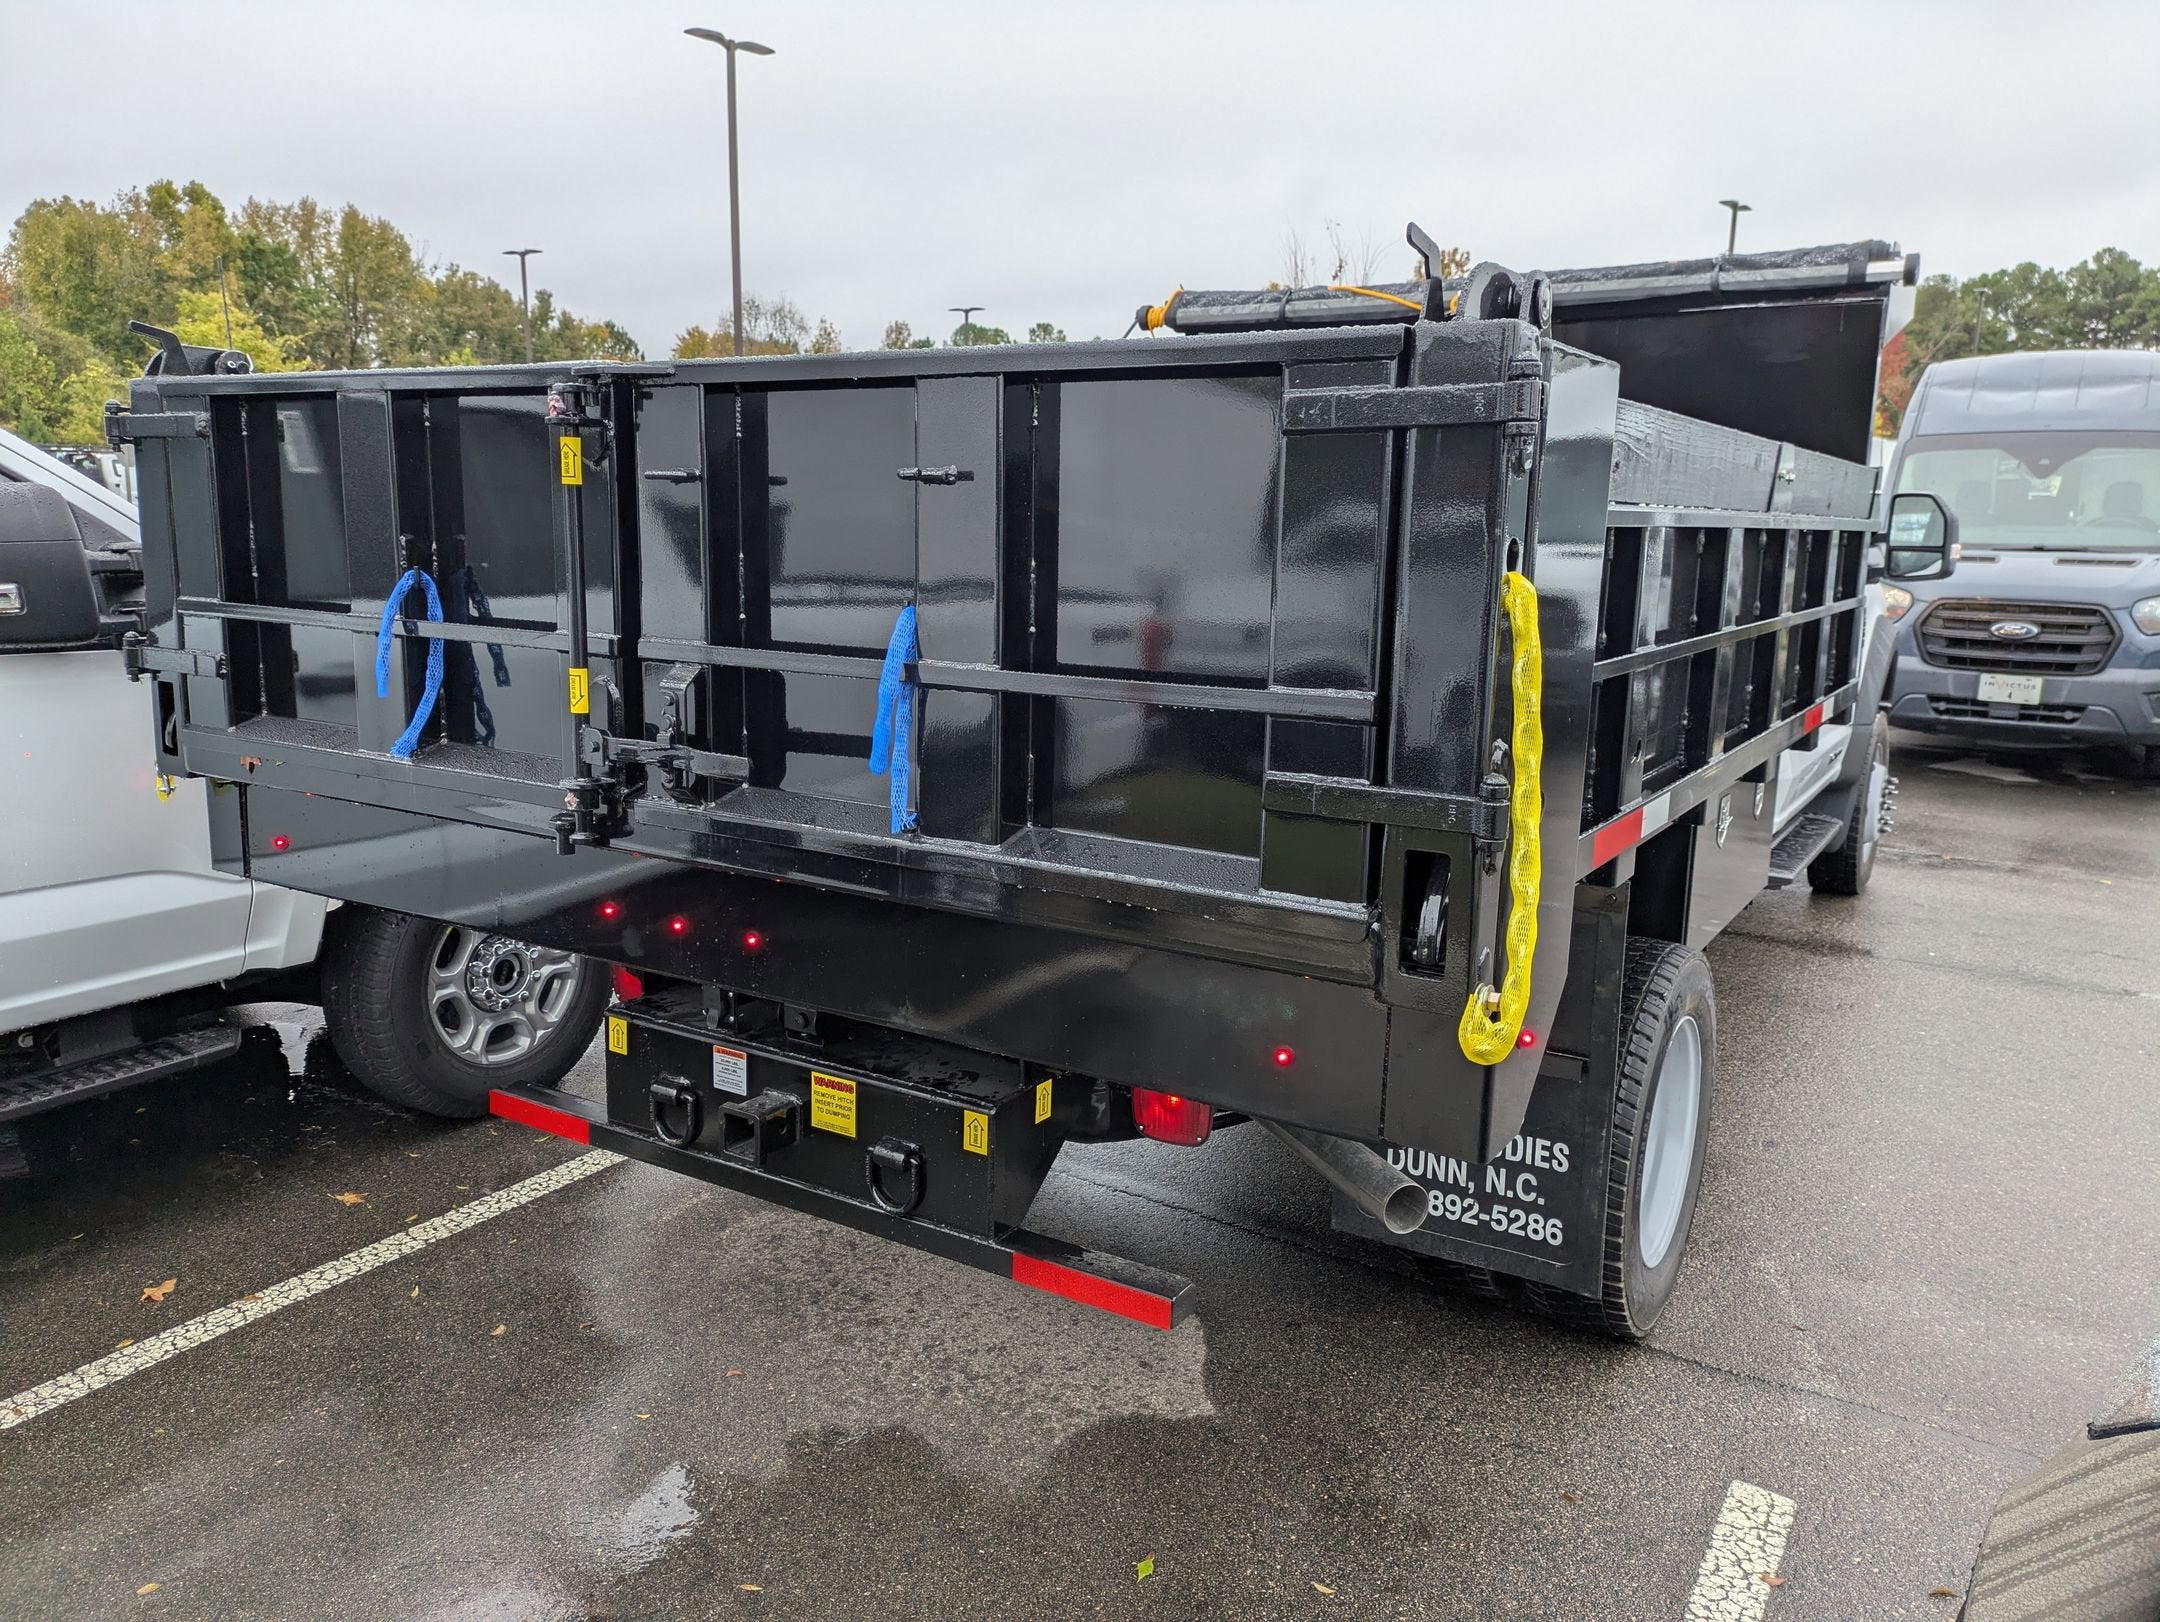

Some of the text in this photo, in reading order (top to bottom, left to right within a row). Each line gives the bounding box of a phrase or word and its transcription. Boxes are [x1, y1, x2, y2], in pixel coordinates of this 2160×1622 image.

[814, 1075, 854, 1094] WARNING
[814, 1090, 854, 1105] REMOVE HITCH
[815, 1098, 852, 1112] INSERT PRIOR
[825, 1109, 850, 1120] DUMPING
[1486, 1165, 1546, 1206] N.C.
[1428, 1189, 1564, 1246] 892-5286
